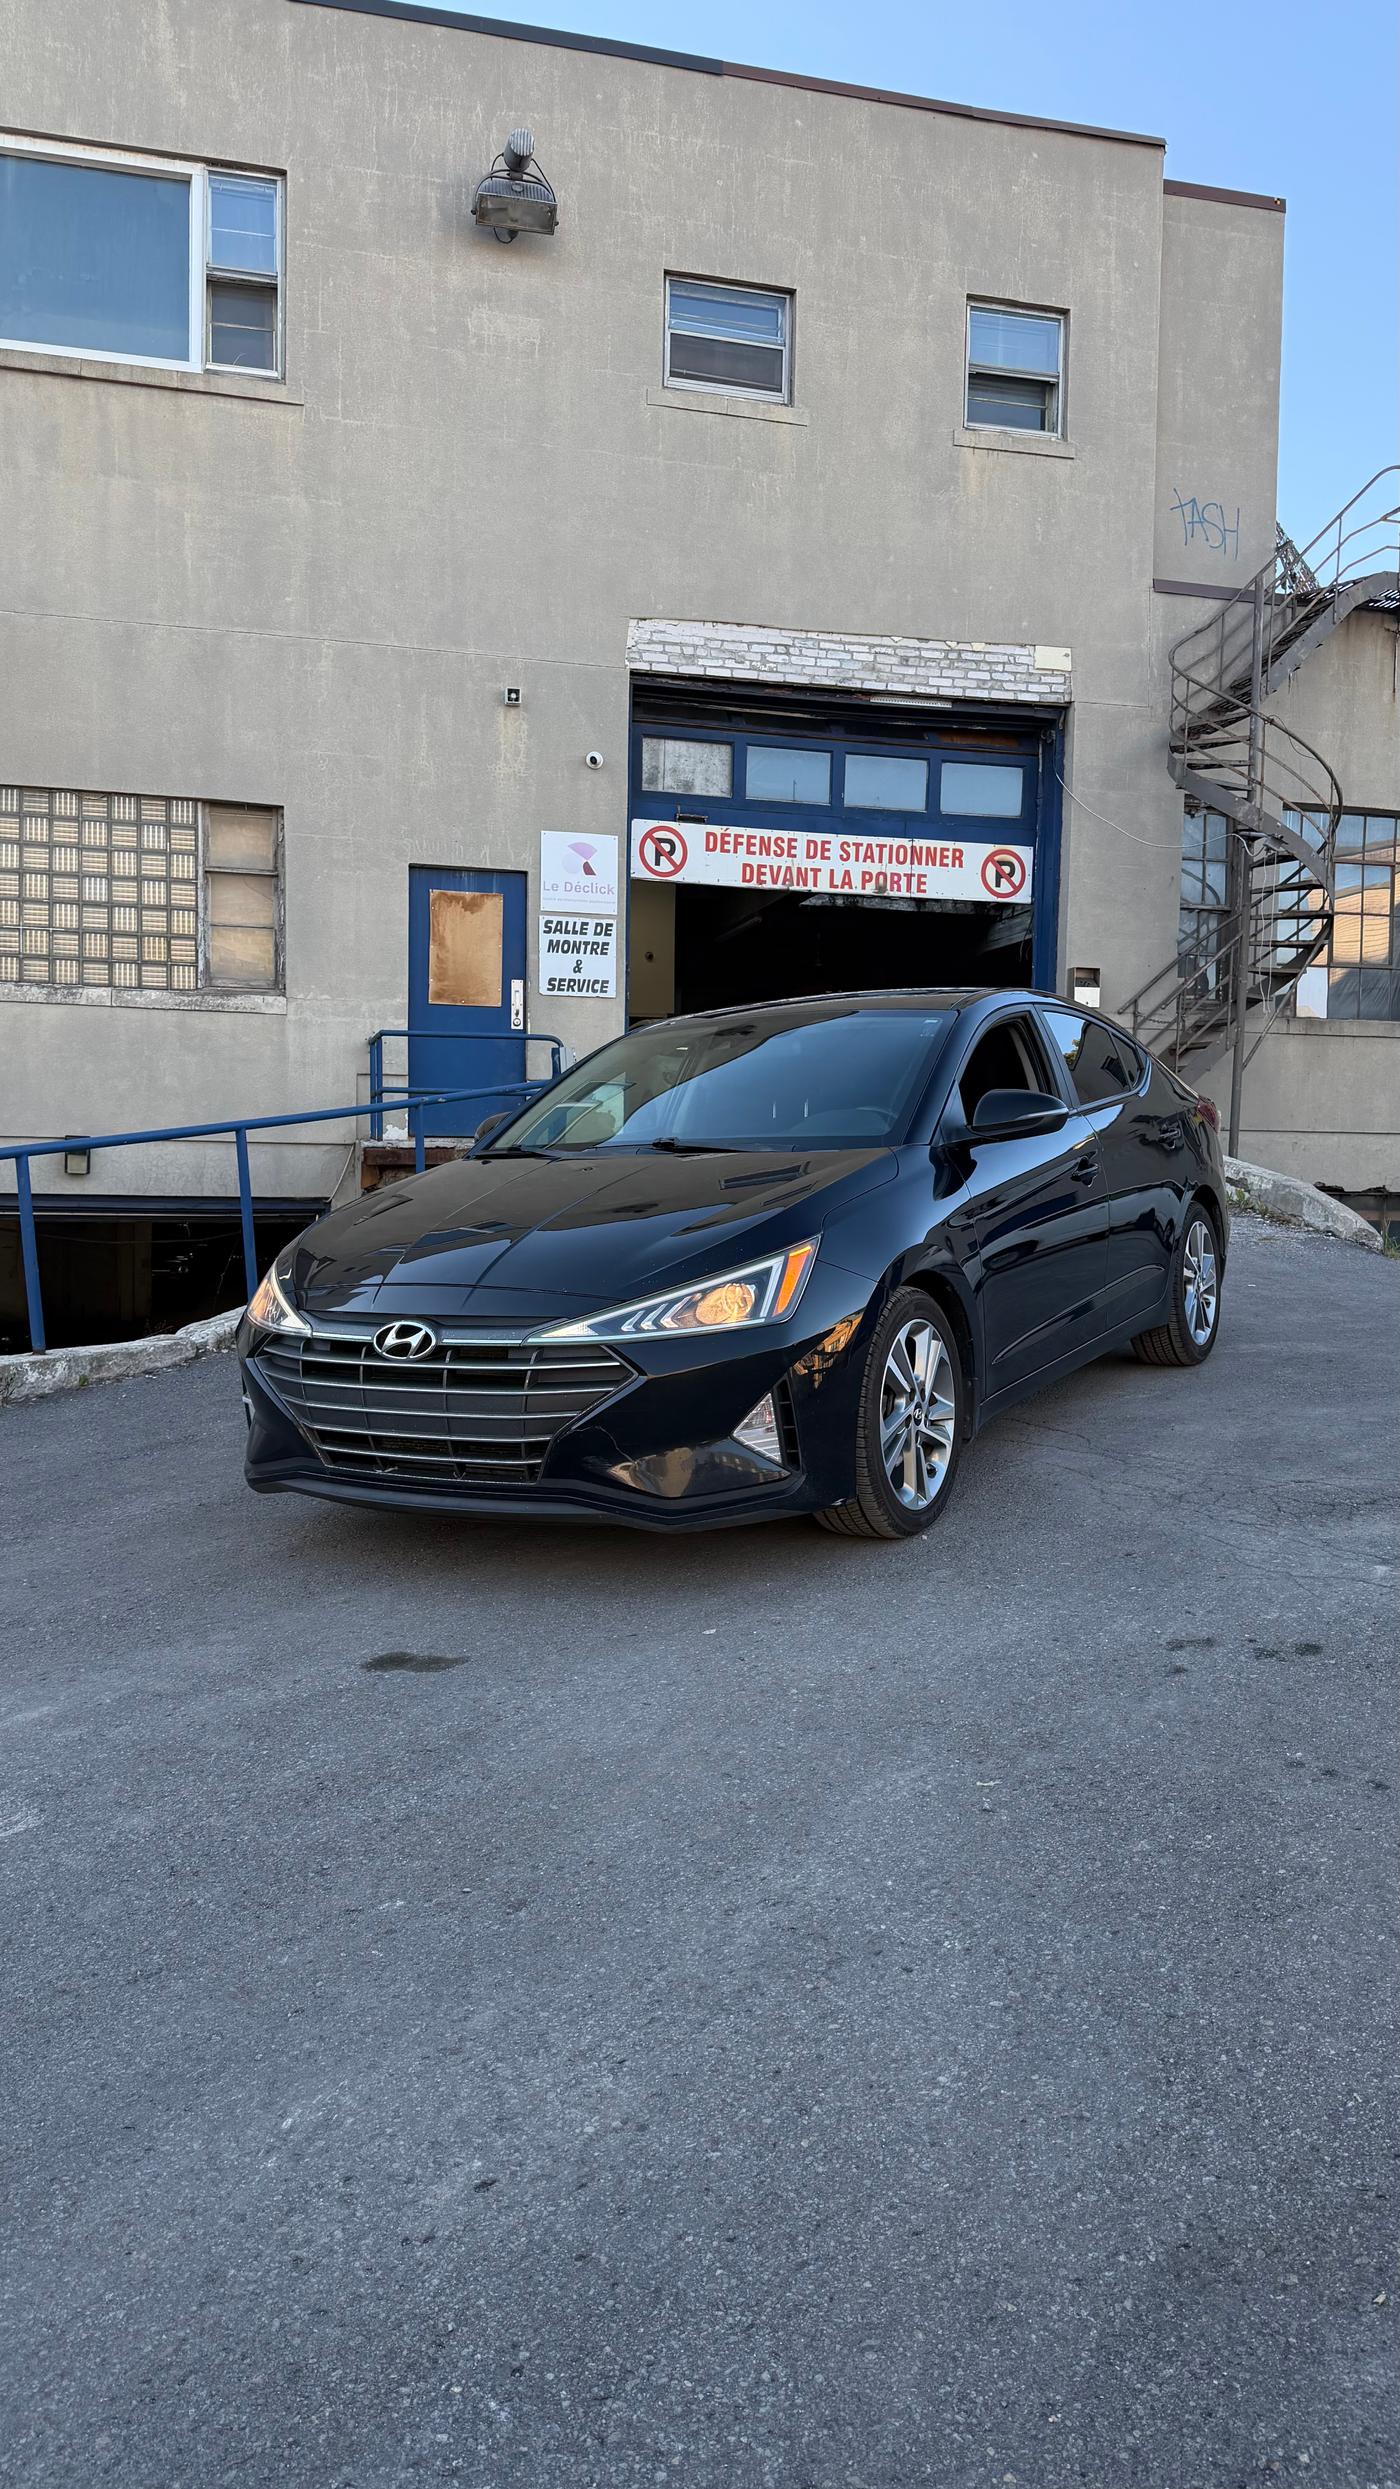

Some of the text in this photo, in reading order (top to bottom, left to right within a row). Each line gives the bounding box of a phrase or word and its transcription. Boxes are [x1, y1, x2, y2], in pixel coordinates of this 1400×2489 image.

[705, 828, 964, 868] DÉFENSE DE STATIONNER
[742, 863, 928, 894] DEVANT LA PORTE
[543, 880, 615, 895] Le Déclick
[543, 919, 613, 937] SALLE DE
[547, 939, 610, 956] MONTRE
[573, 959, 583, 974] &
[547, 977, 609, 994] SERVICE
